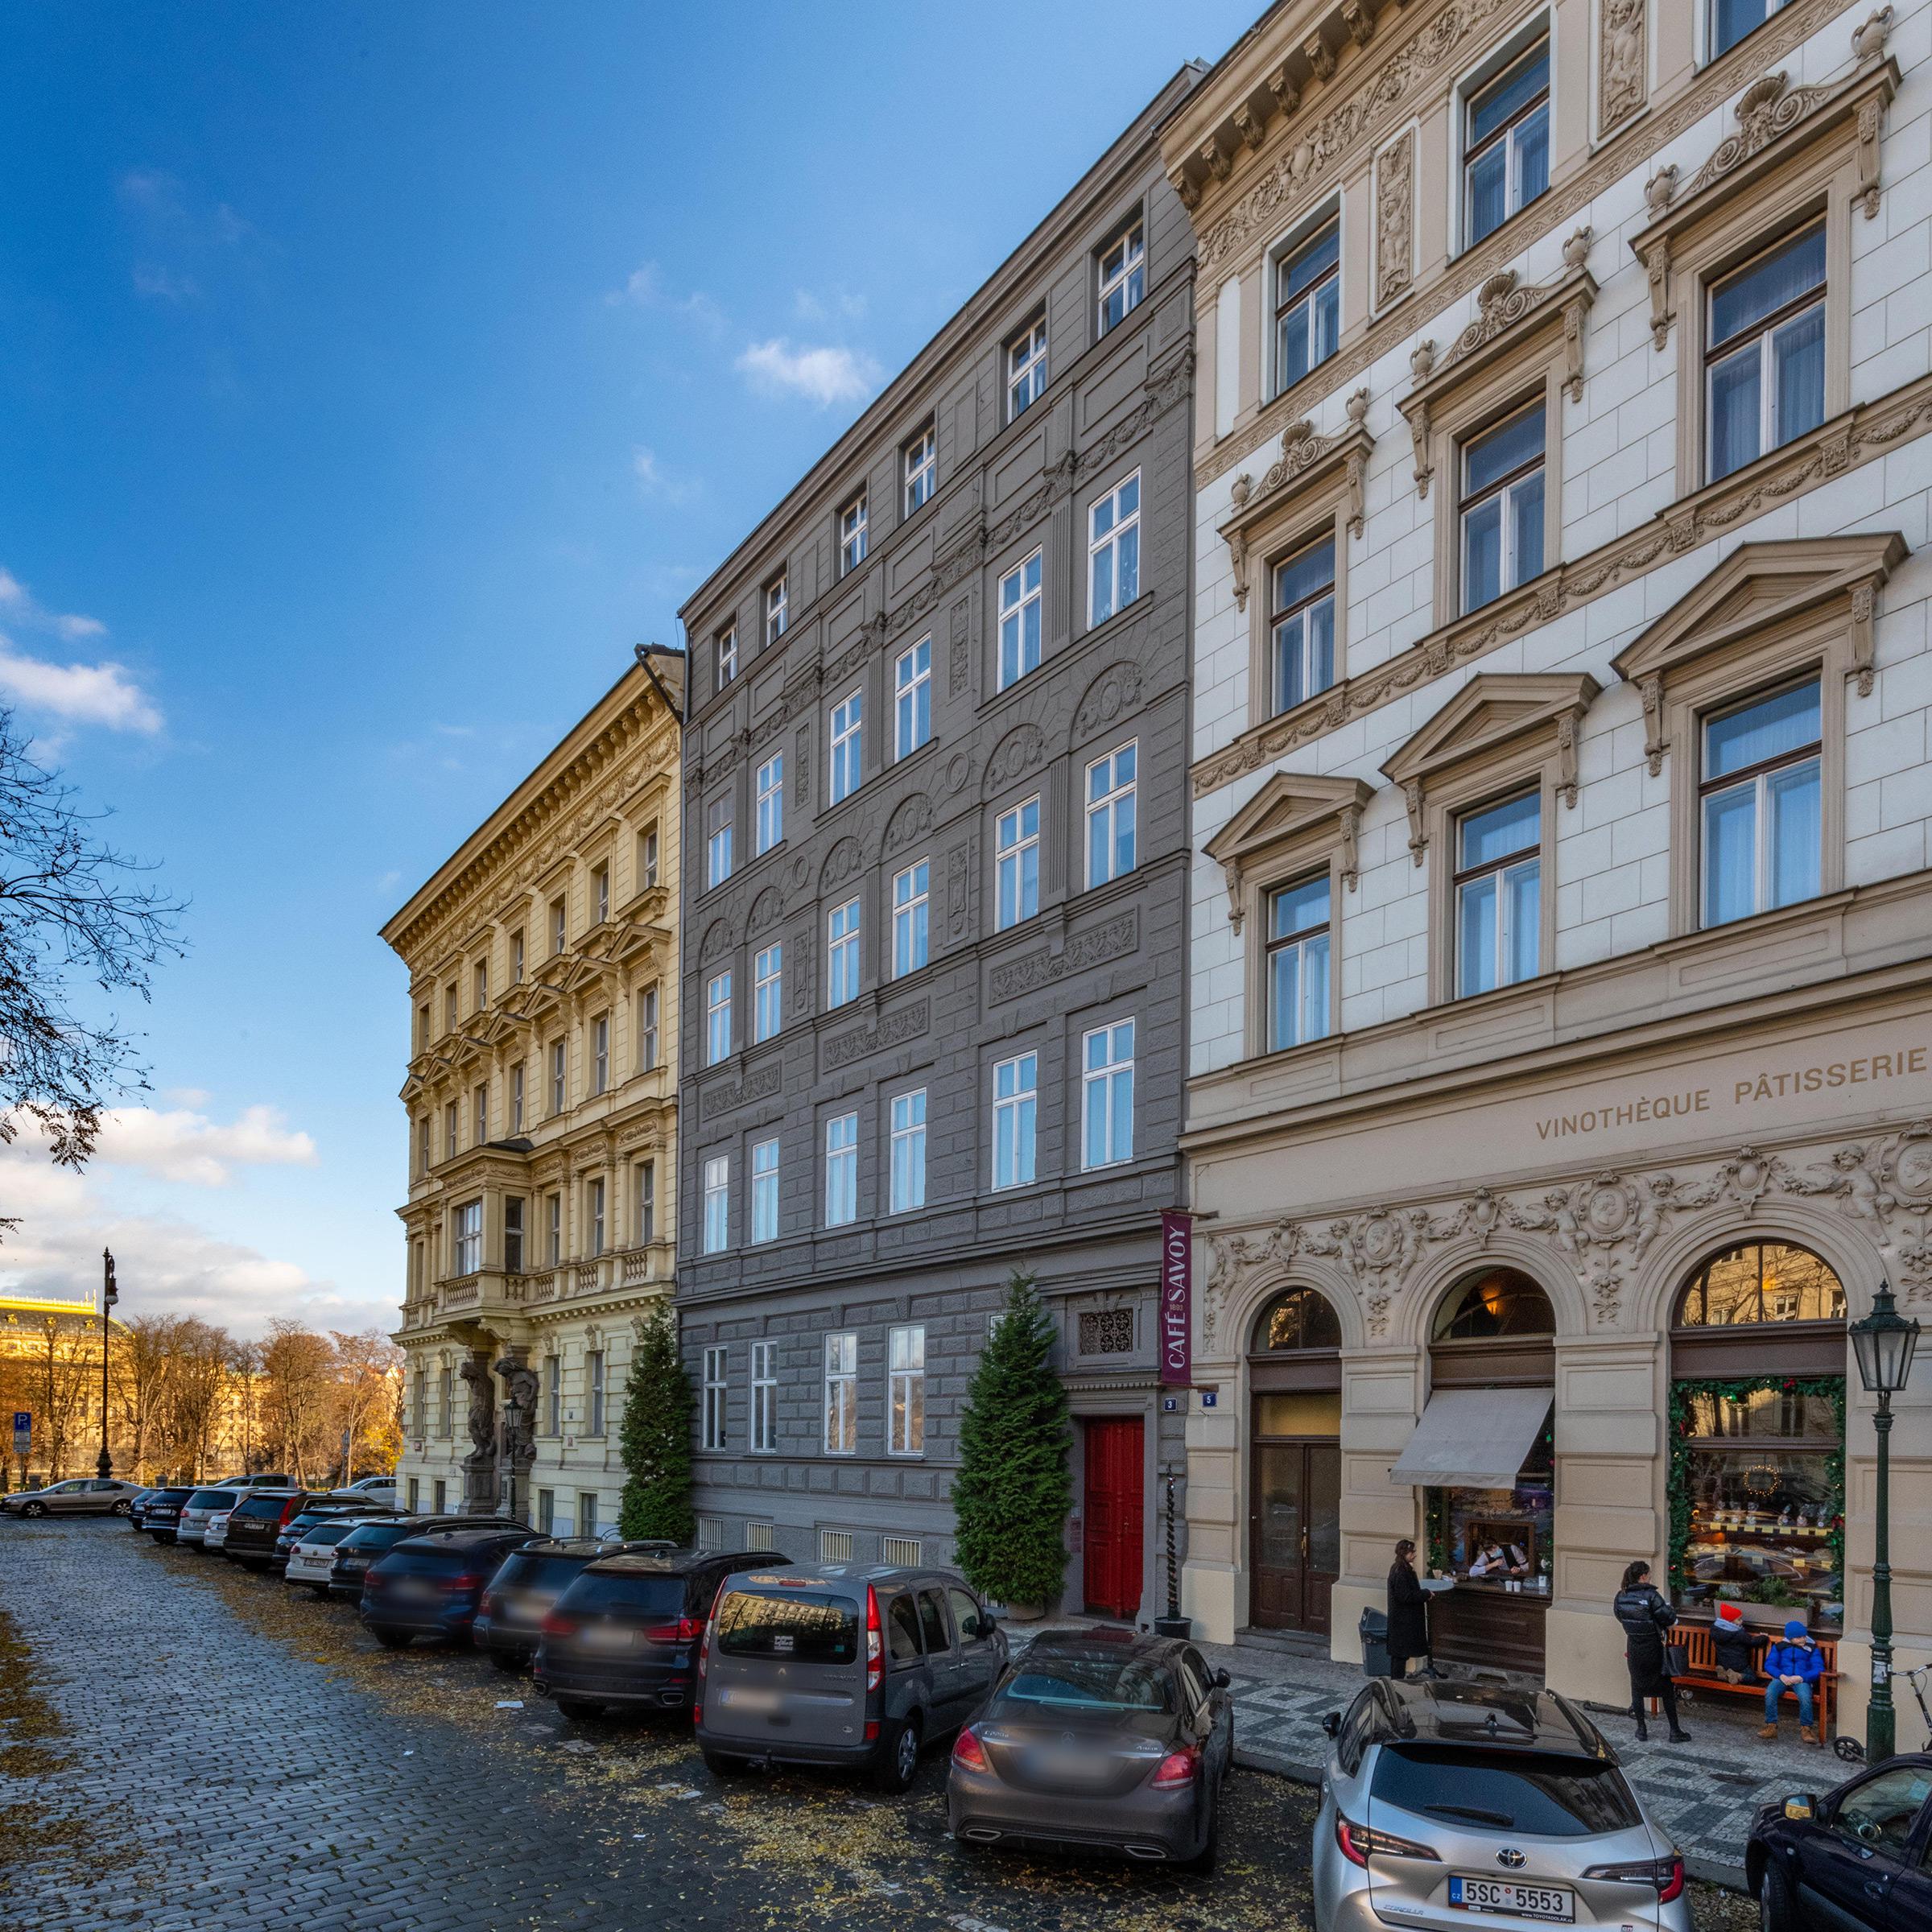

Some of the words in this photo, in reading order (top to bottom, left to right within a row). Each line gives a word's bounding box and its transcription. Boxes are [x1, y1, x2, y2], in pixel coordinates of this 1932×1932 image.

[1535, 1088, 1711, 1141] VINOTHÈQUE
[1735, 1046, 1928, 1105] PÂTISSERIE
[1167, 1225, 1186, 1302] SAVOY
[1164, 1311, 1186, 1369] CAFÉ
[1167, 1401, 1173, 1409] 3
[1206, 1395, 1212, 1404] 5
[18, 1414, 27, 1426] P
[1466, 1882, 1501, 1904] 5SC
[1516, 1889, 1563, 1913] 5553
